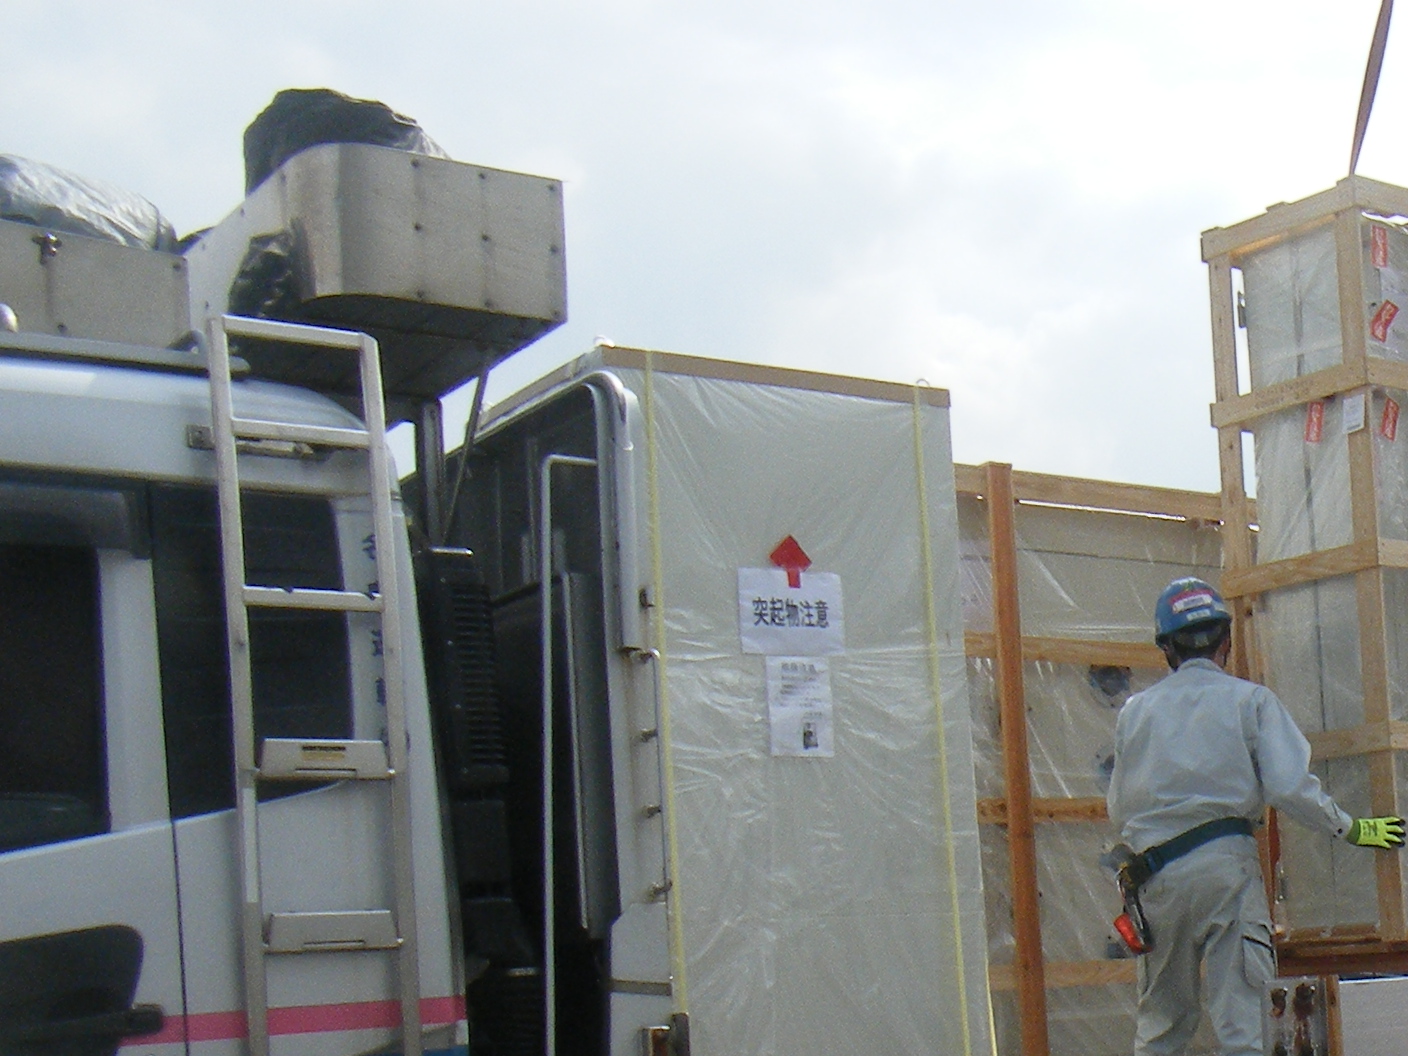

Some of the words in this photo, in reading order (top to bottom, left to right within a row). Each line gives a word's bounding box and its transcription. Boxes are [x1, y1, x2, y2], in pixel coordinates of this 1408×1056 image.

[752, 597, 829, 628] 突起物注意
